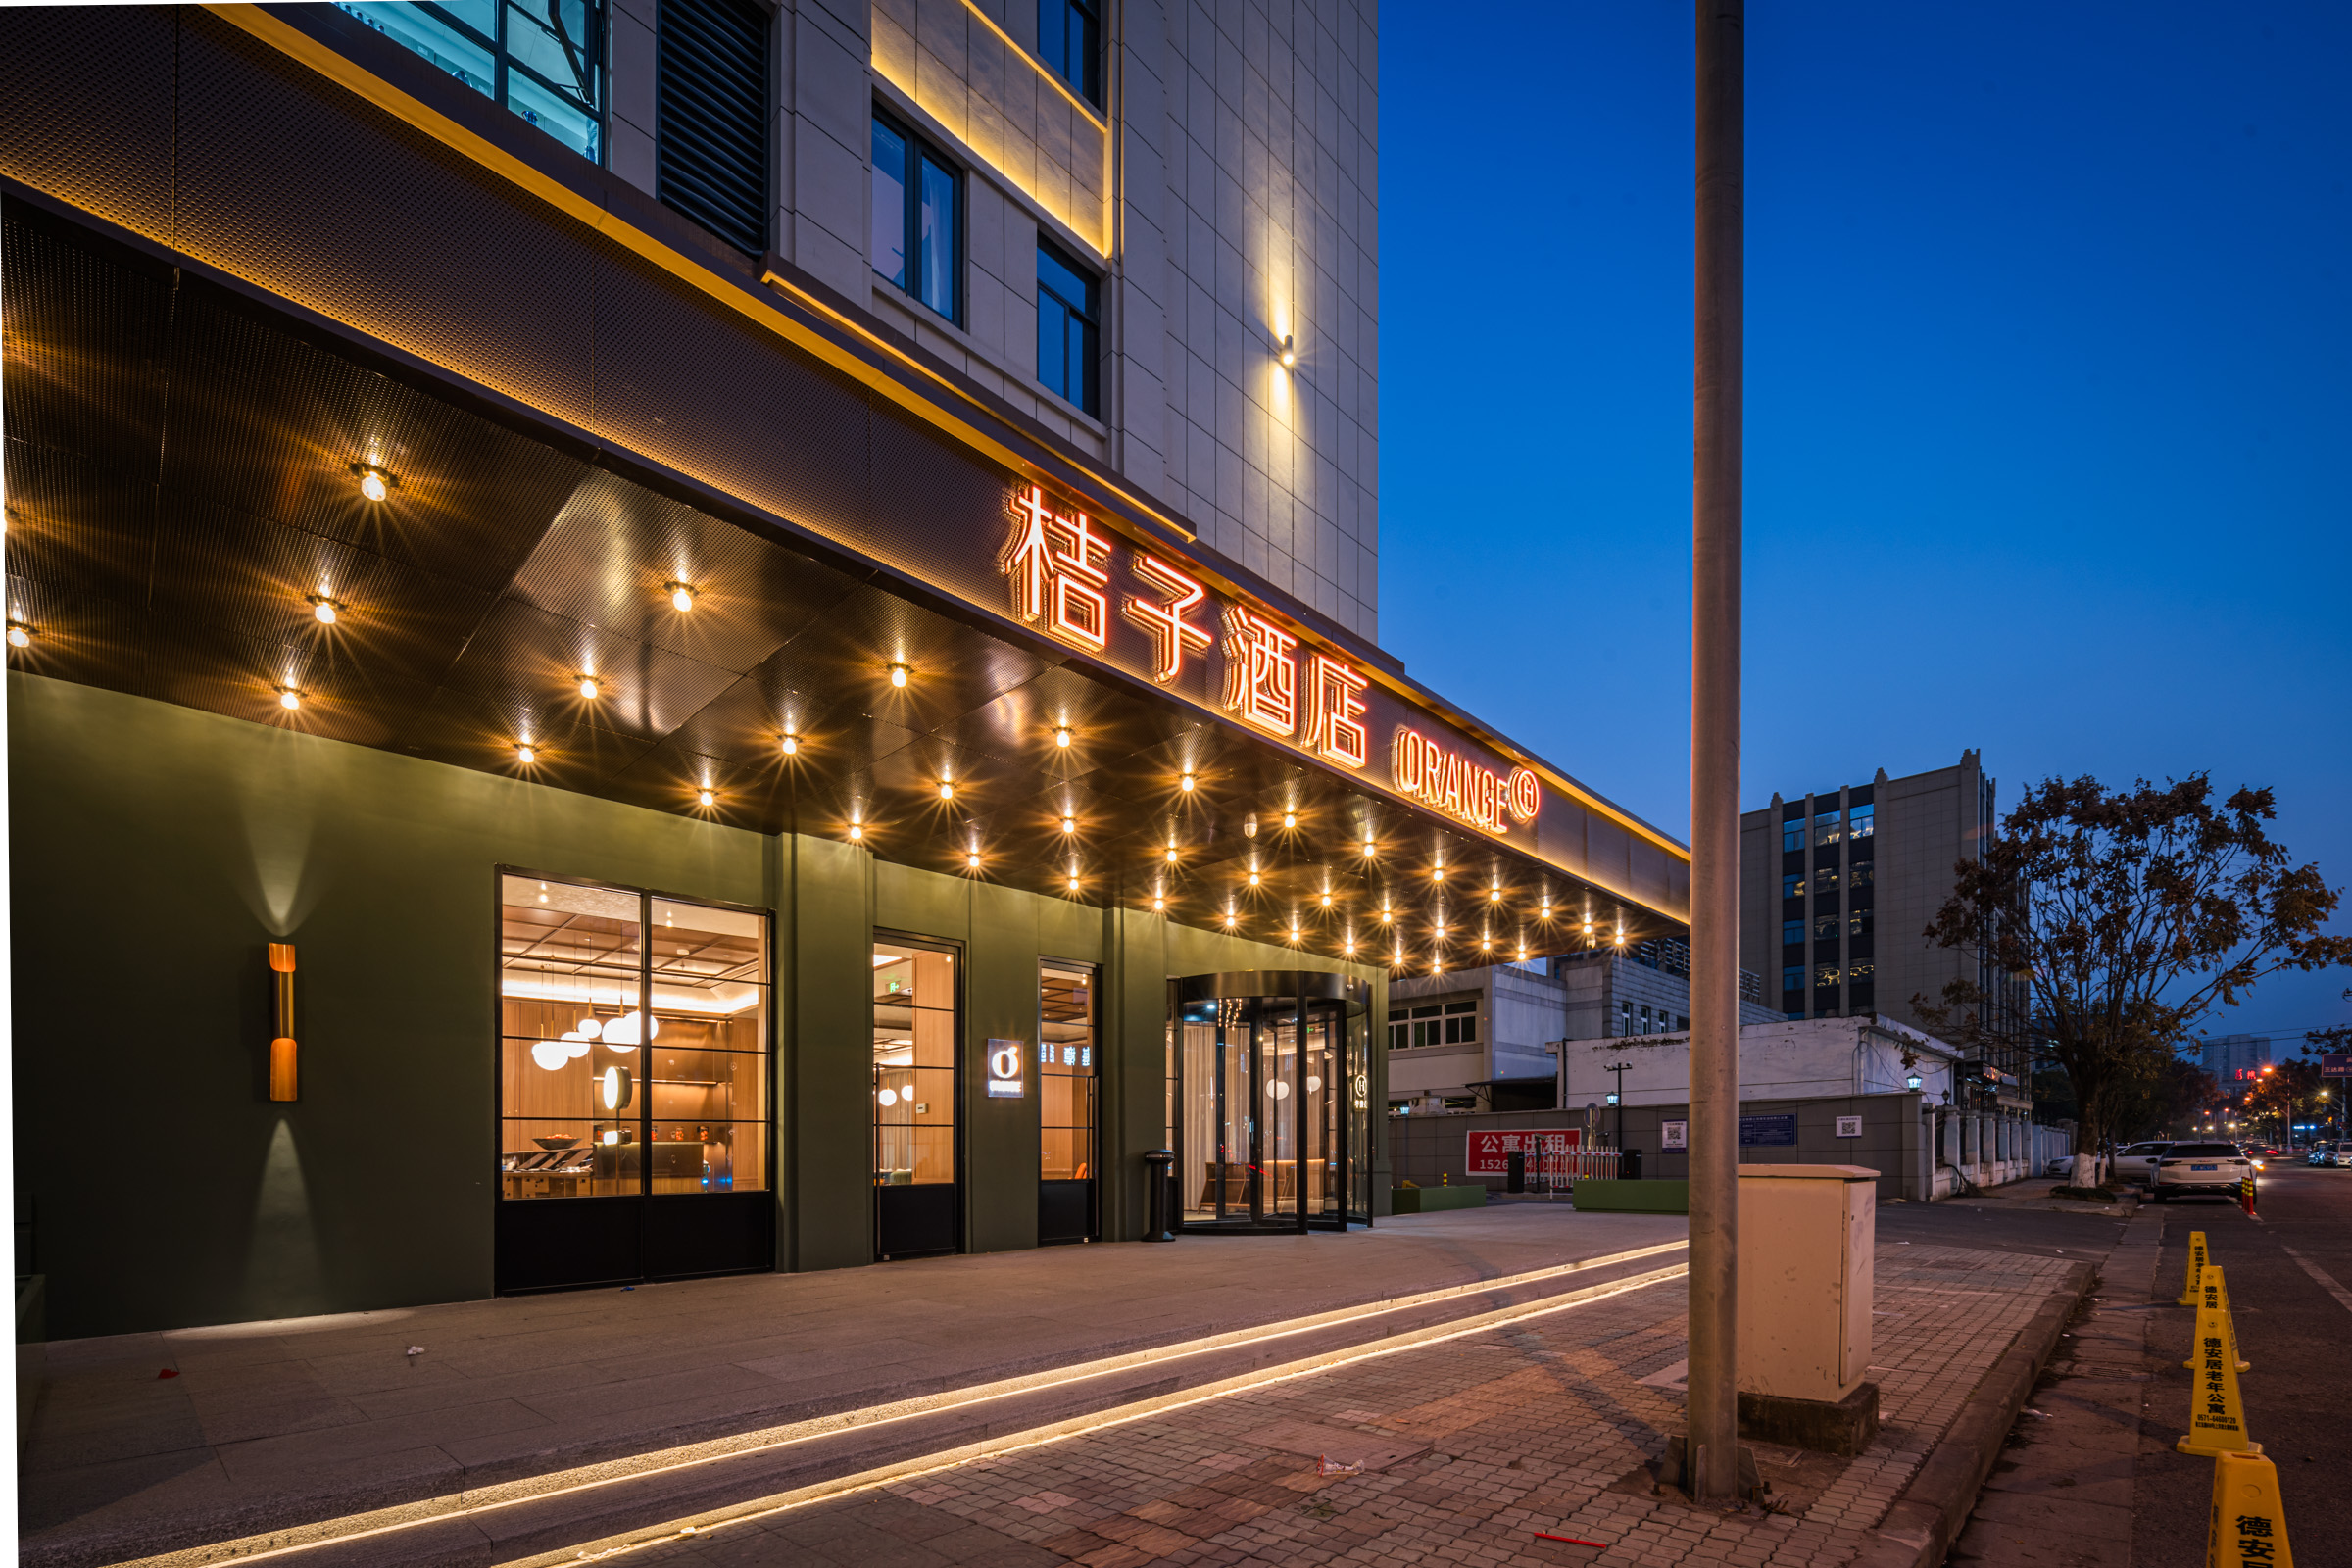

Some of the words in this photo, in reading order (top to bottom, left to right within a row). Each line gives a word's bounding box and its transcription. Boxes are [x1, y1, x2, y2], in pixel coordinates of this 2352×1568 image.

[1002, 486, 1368, 769] 桔子酒店
[1396, 731, 1507, 834] ORANGE
[1480, 1133, 1565, 1154] 公寓出租
[2203, 1337, 2225, 1415] 德安居老年公寓
